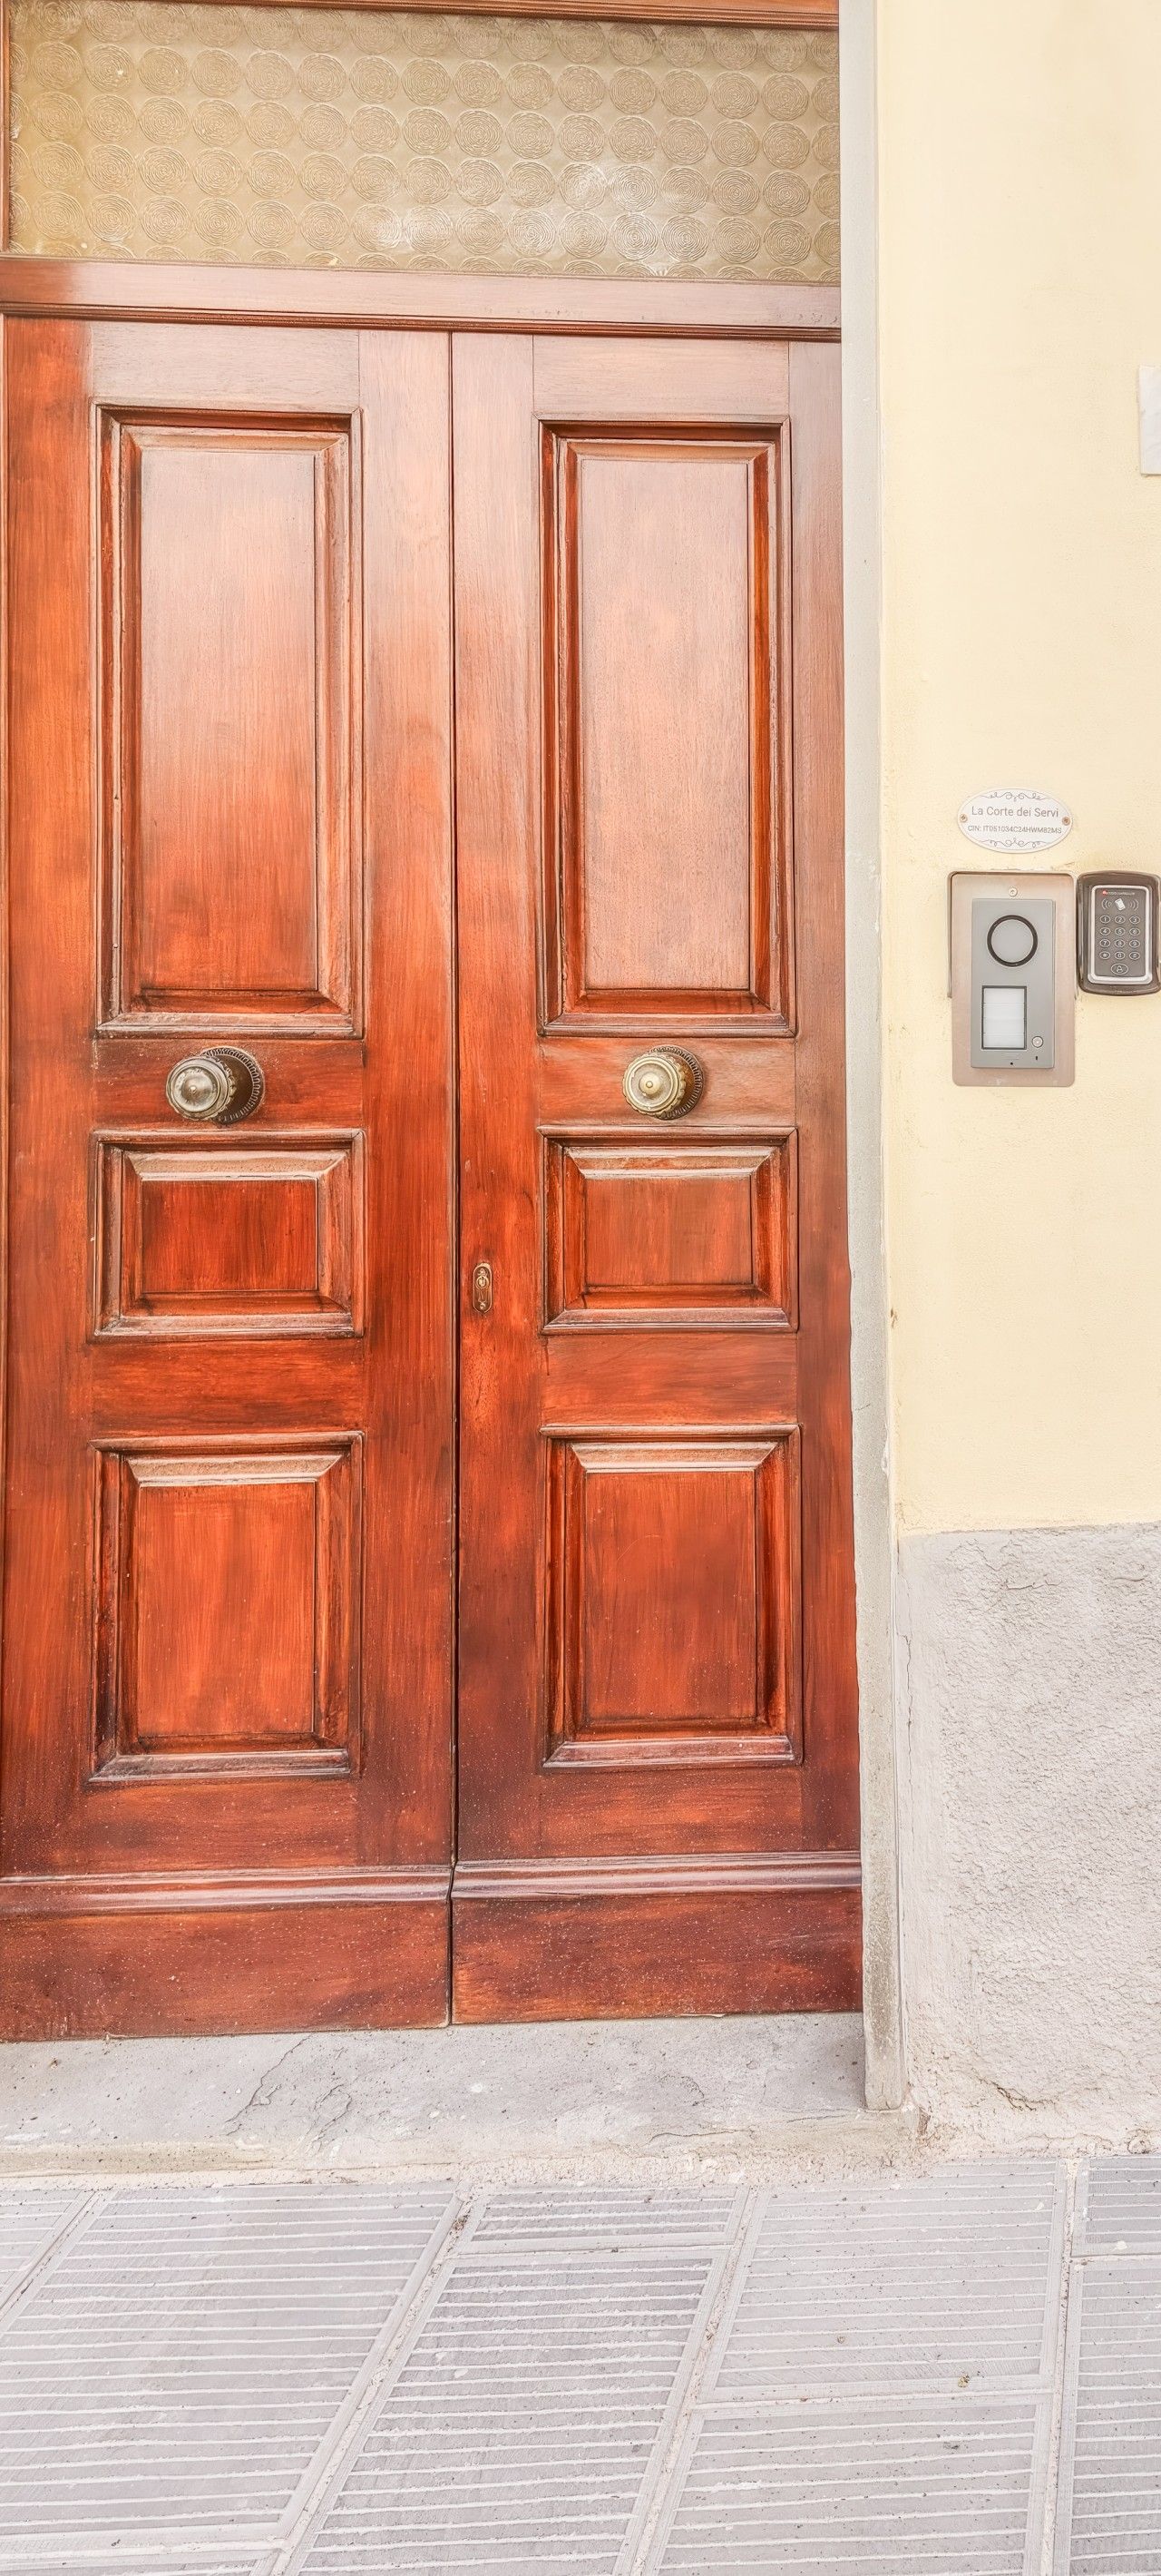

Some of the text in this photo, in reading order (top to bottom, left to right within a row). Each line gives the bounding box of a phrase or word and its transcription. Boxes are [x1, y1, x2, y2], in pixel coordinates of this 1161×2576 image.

[971, 806, 1059, 818] La Corte dei Servi
